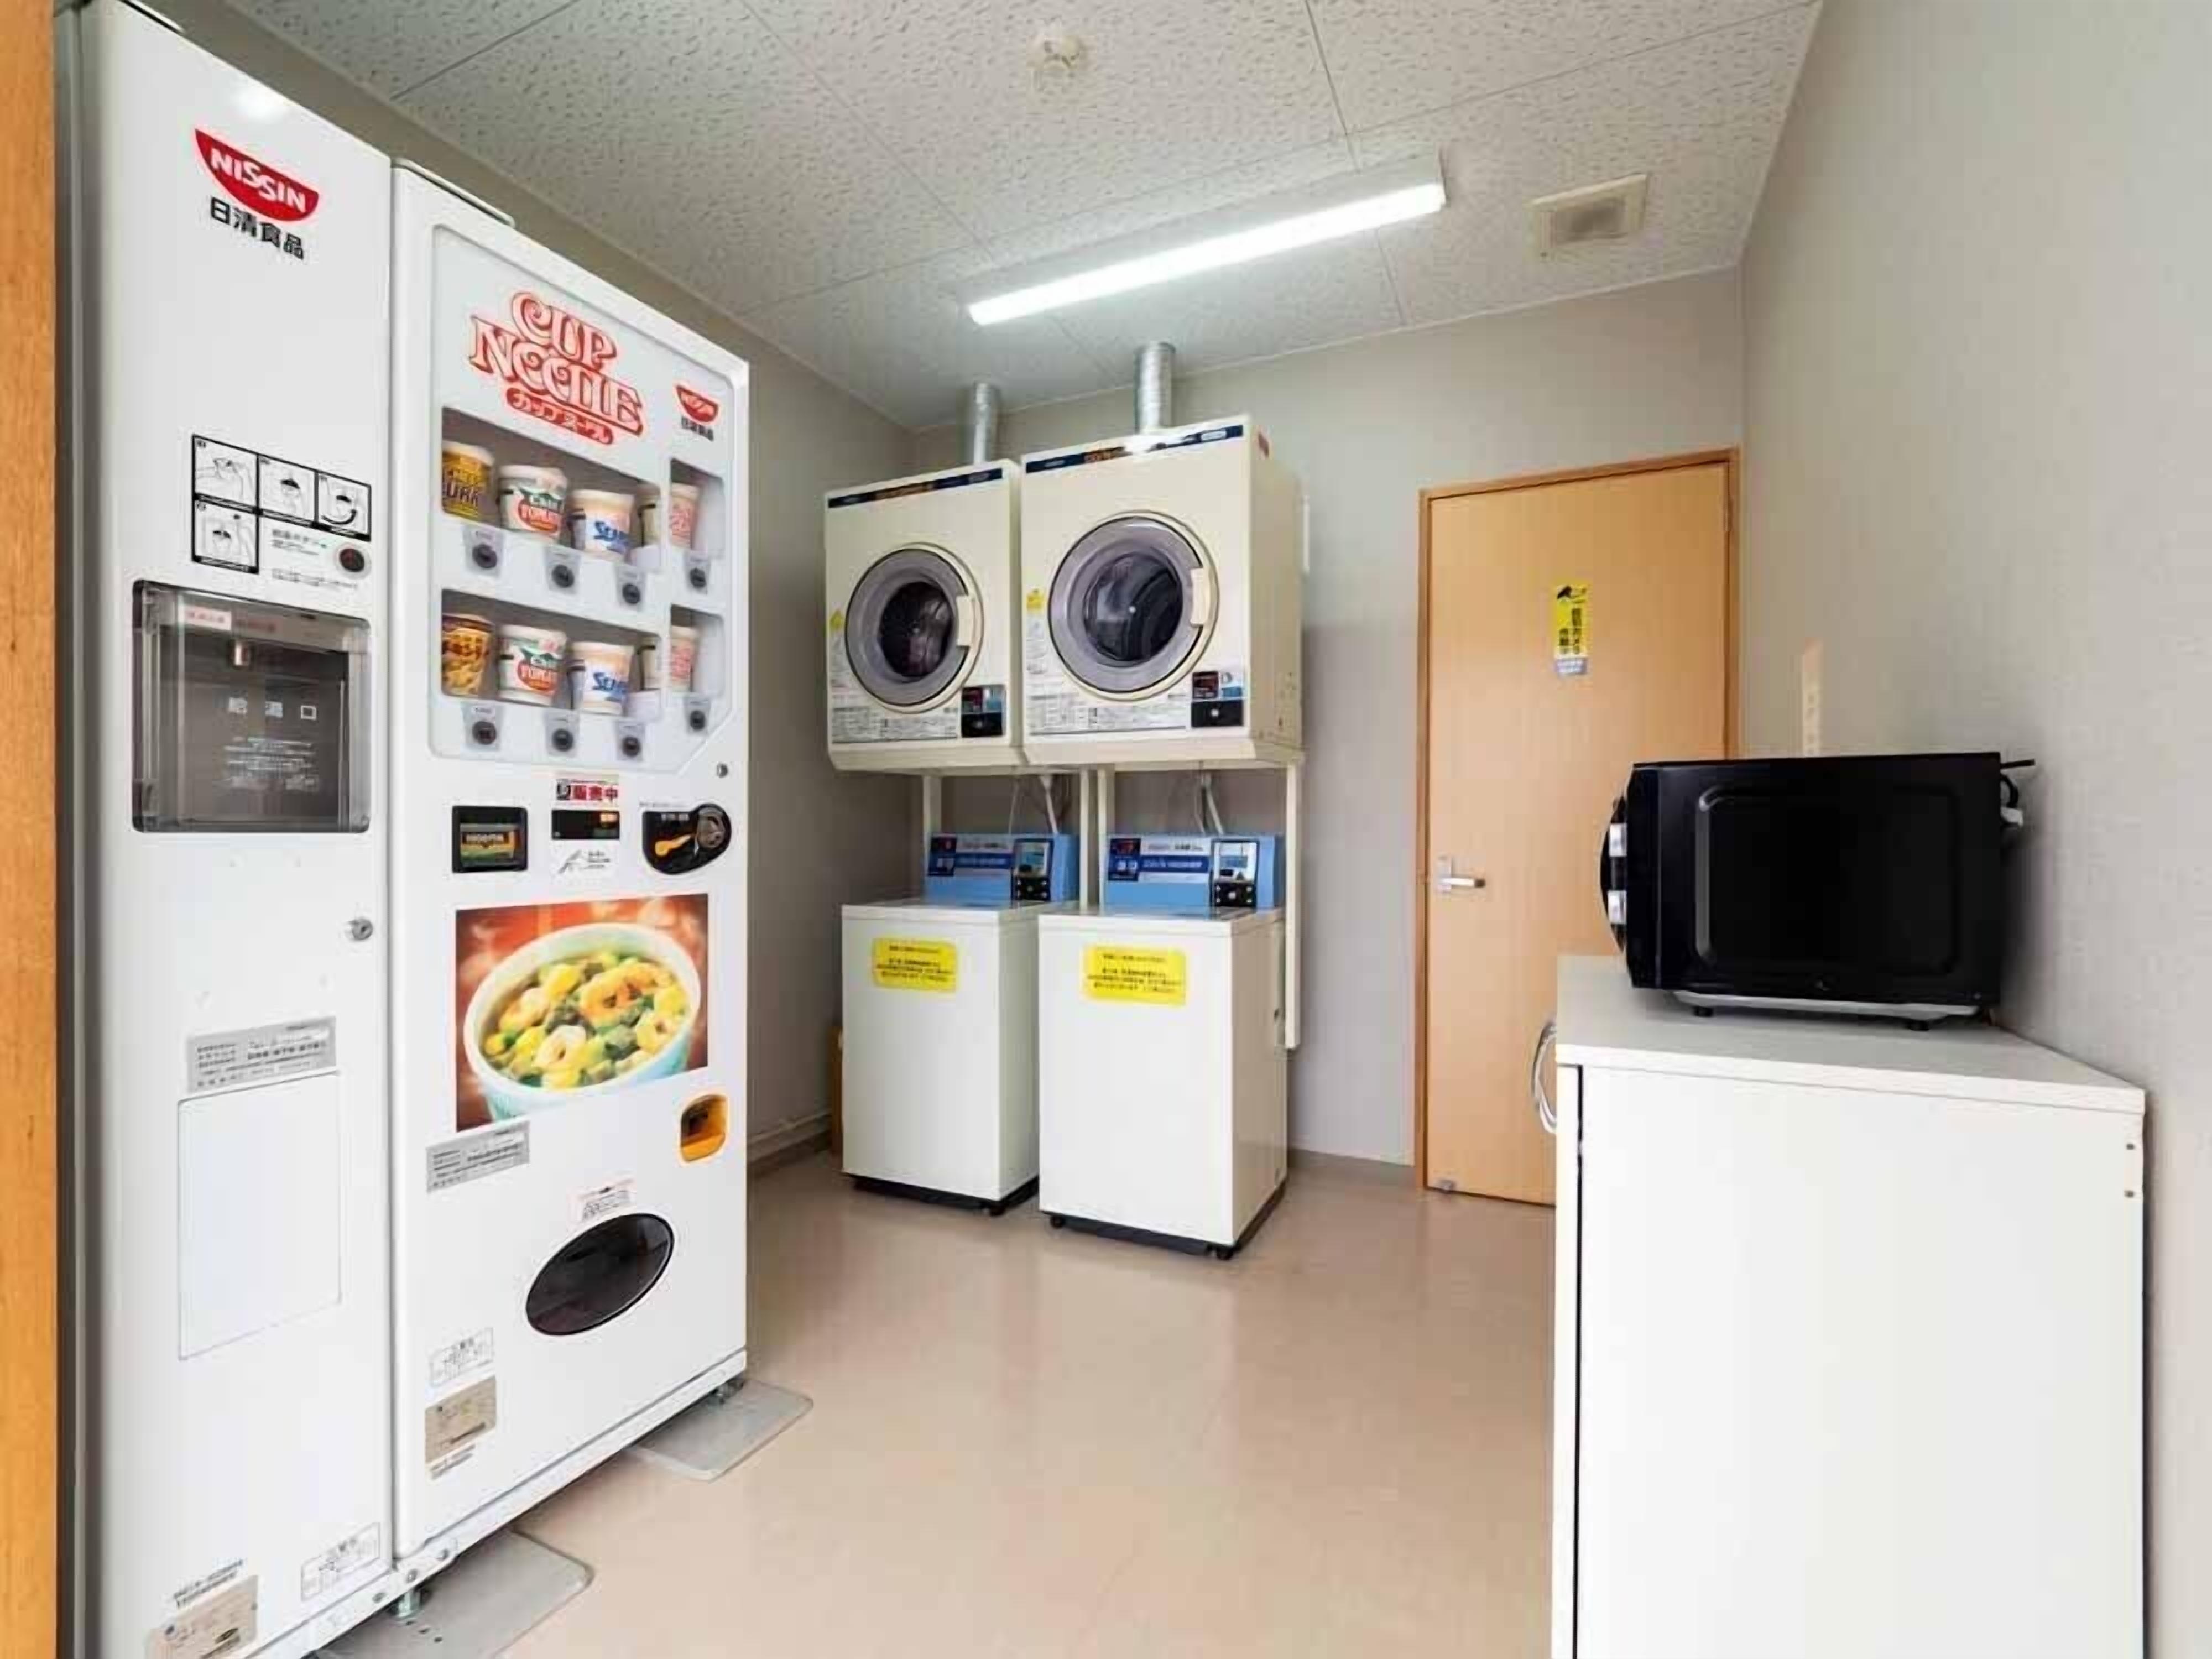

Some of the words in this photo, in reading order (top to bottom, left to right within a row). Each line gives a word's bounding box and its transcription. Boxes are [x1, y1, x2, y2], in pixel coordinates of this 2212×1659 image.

[210, 147, 306, 213] NISSIN
[210, 195, 304, 260] 日清食品
[511, 291, 618, 370] CUP
[468, 314, 644, 437] NOODLE
